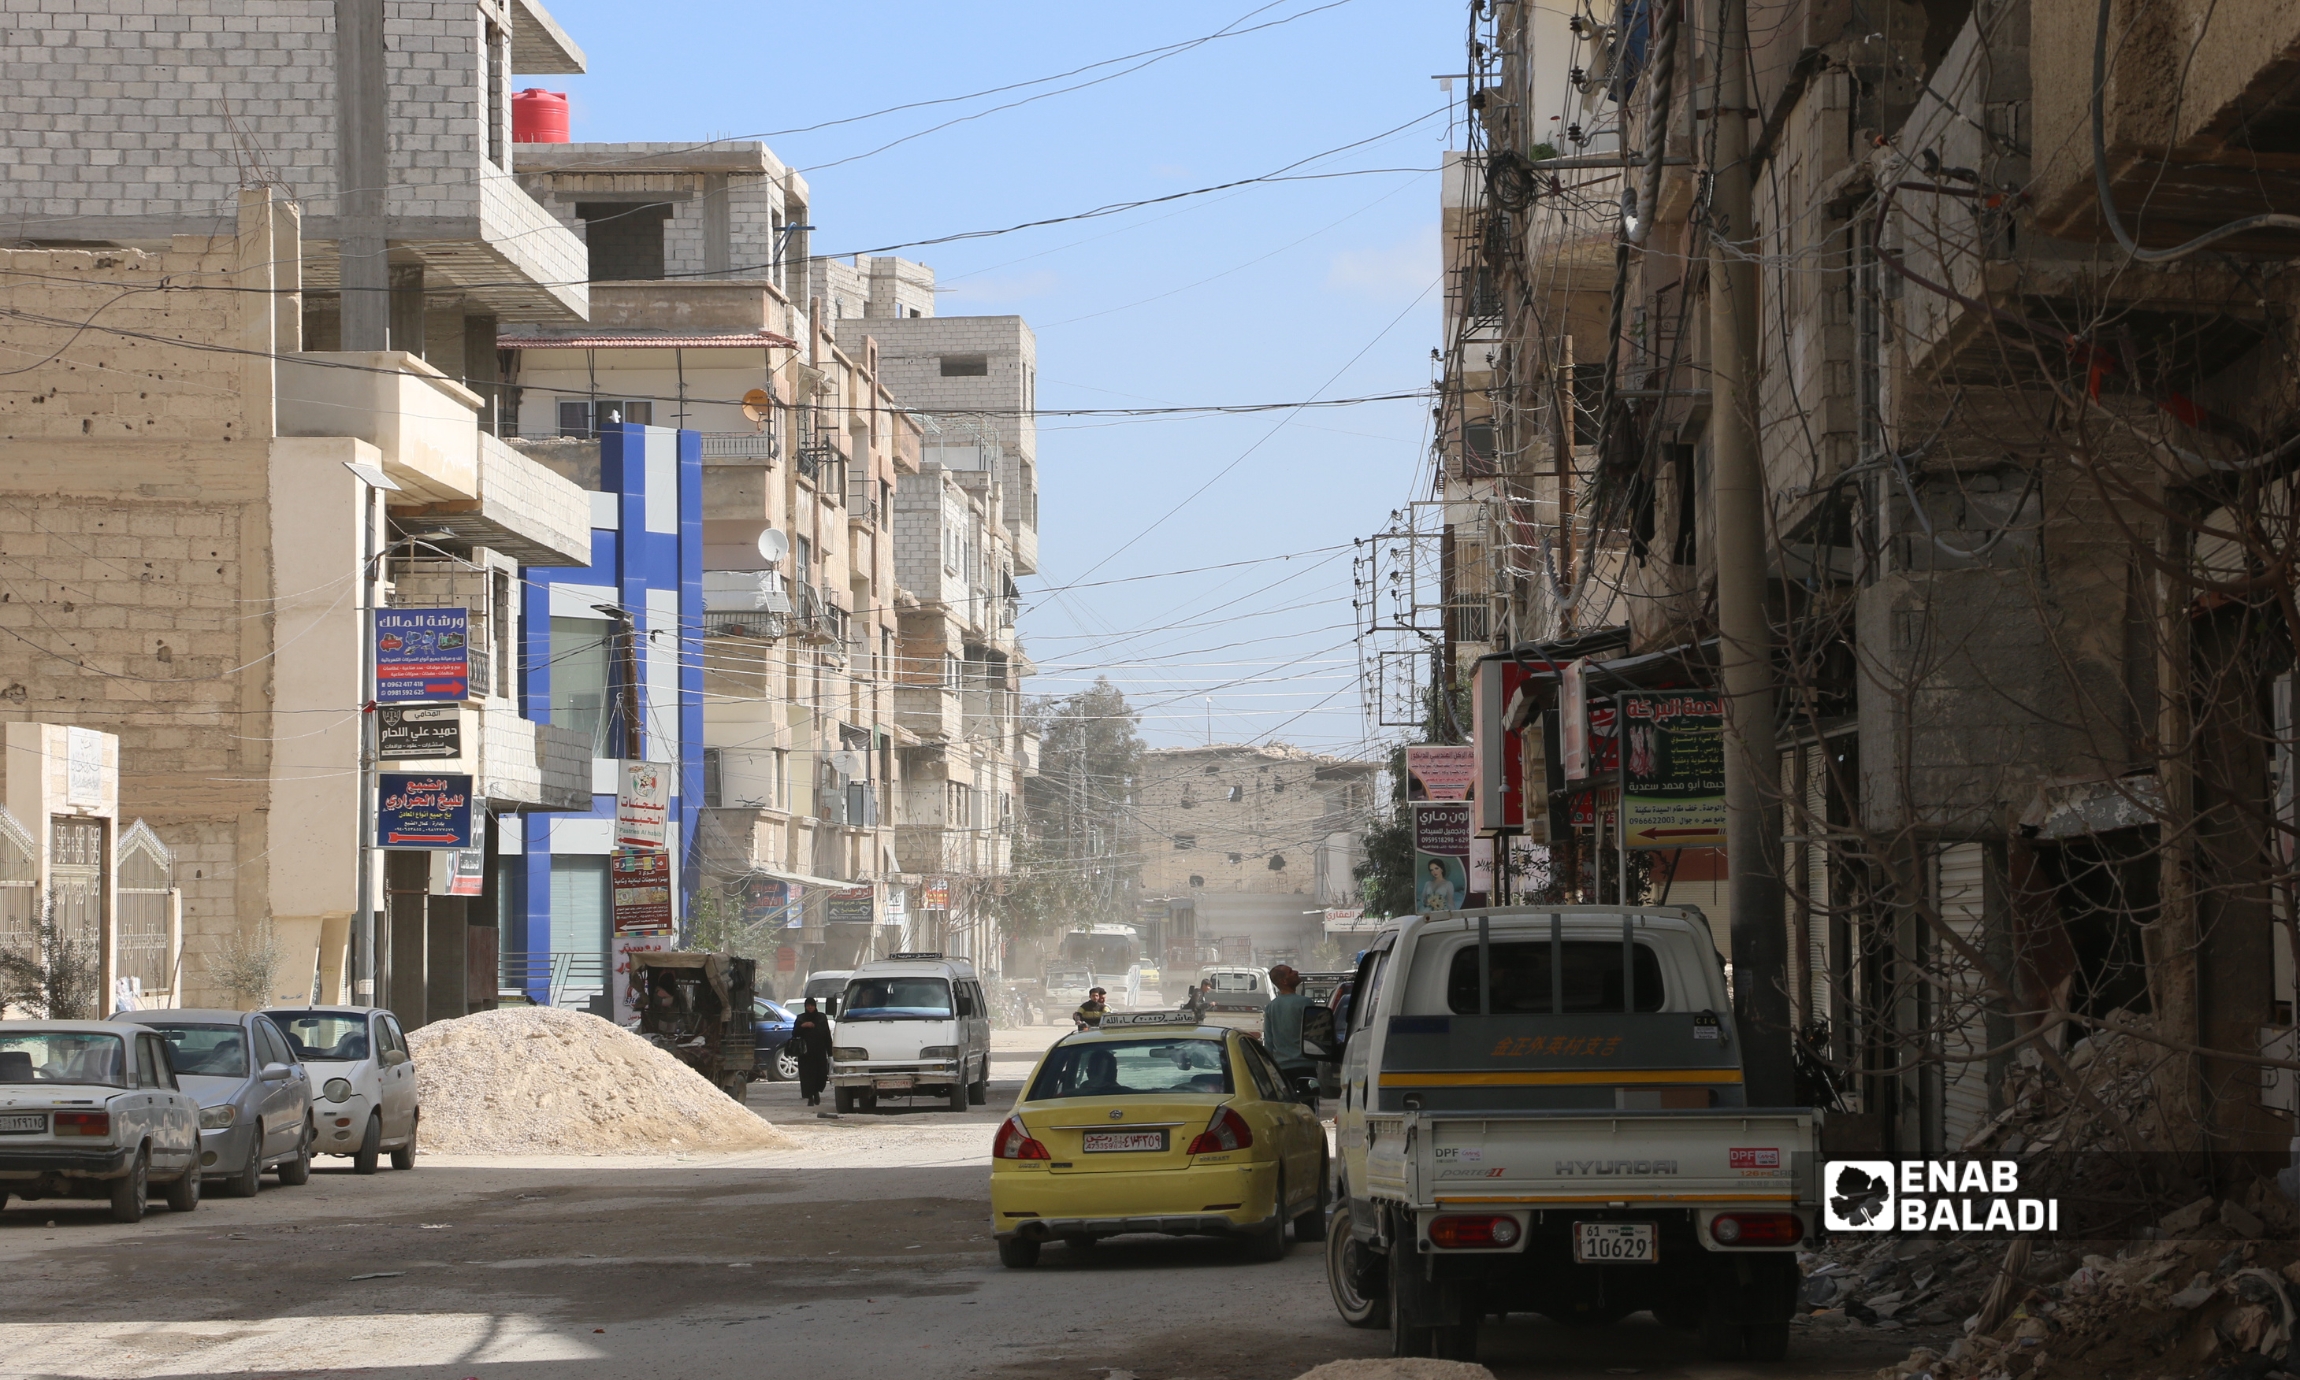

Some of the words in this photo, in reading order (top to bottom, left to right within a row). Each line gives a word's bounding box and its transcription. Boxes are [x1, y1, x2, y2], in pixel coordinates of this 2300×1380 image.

[379, 615, 423, 628] المالك
[426, 615, 464, 629] ورشة
[1626, 698, 1681, 722] البركة
[1681, 697, 1724, 717] لحمة
[414, 710, 441, 719] المحامي
[381, 726, 408, 742] اللحام
[410, 726, 429, 741] علي
[432, 727, 457, 738] حميد
[1628, 782, 1659, 793] سعدية
[1662, 782, 1685, 790] محمد
[1687, 778, 1700, 791] أبو
[1703, 780, 1725, 789] حبها
[385, 793, 435, 811] الحراري
[437, 793, 464, 811] للبخ
[621, 796, 664, 812] معجنات
[620, 815, 663, 826] الحبيب
[1419, 811, 1447, 826] ماري
[1450, 811, 1468, 824] لون
[1106, 1016, 1119, 1024] الله
[1435, 1148, 1459, 1158] DPF
[1730, 1150, 1755, 1161] DPF
[1555, 1160, 1678, 1175] HYUNDAI
[1587, 1226, 1600, 1237] 61
[1587, 1238, 1647, 1258] 10629
